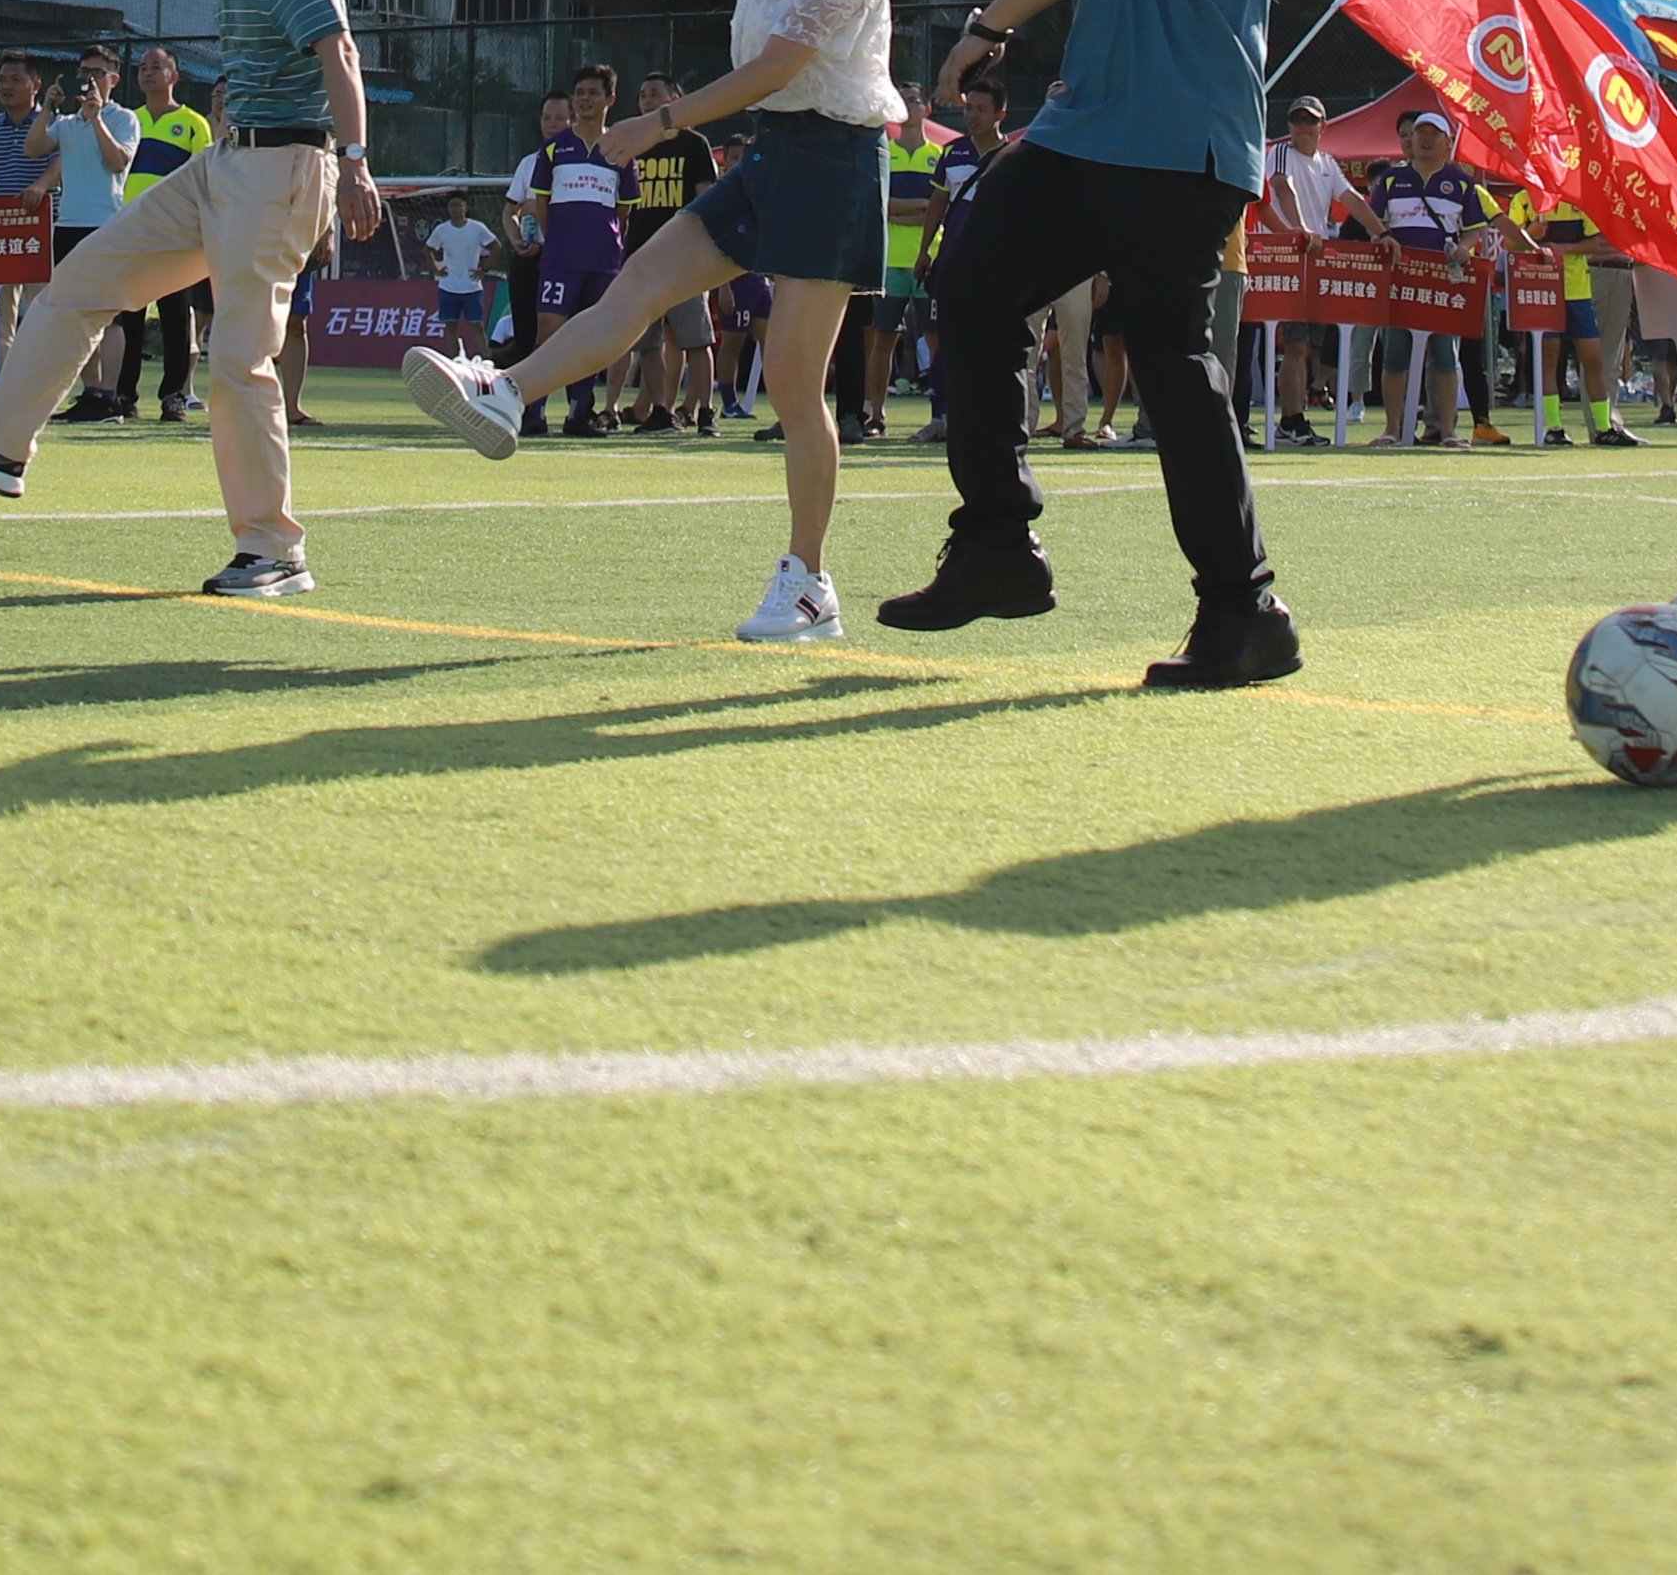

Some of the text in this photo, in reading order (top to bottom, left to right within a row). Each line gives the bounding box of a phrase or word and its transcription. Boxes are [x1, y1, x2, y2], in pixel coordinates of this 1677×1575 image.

[637, 157, 685, 179] COOL!
[637, 180, 683, 209] MAN
[541, 280, 565, 305] 23
[1319, 279, 1377, 299] 罗湖联谊会
[326, 306, 448, 338] 石马联谊会
[735, 310, 751, 327] 19
